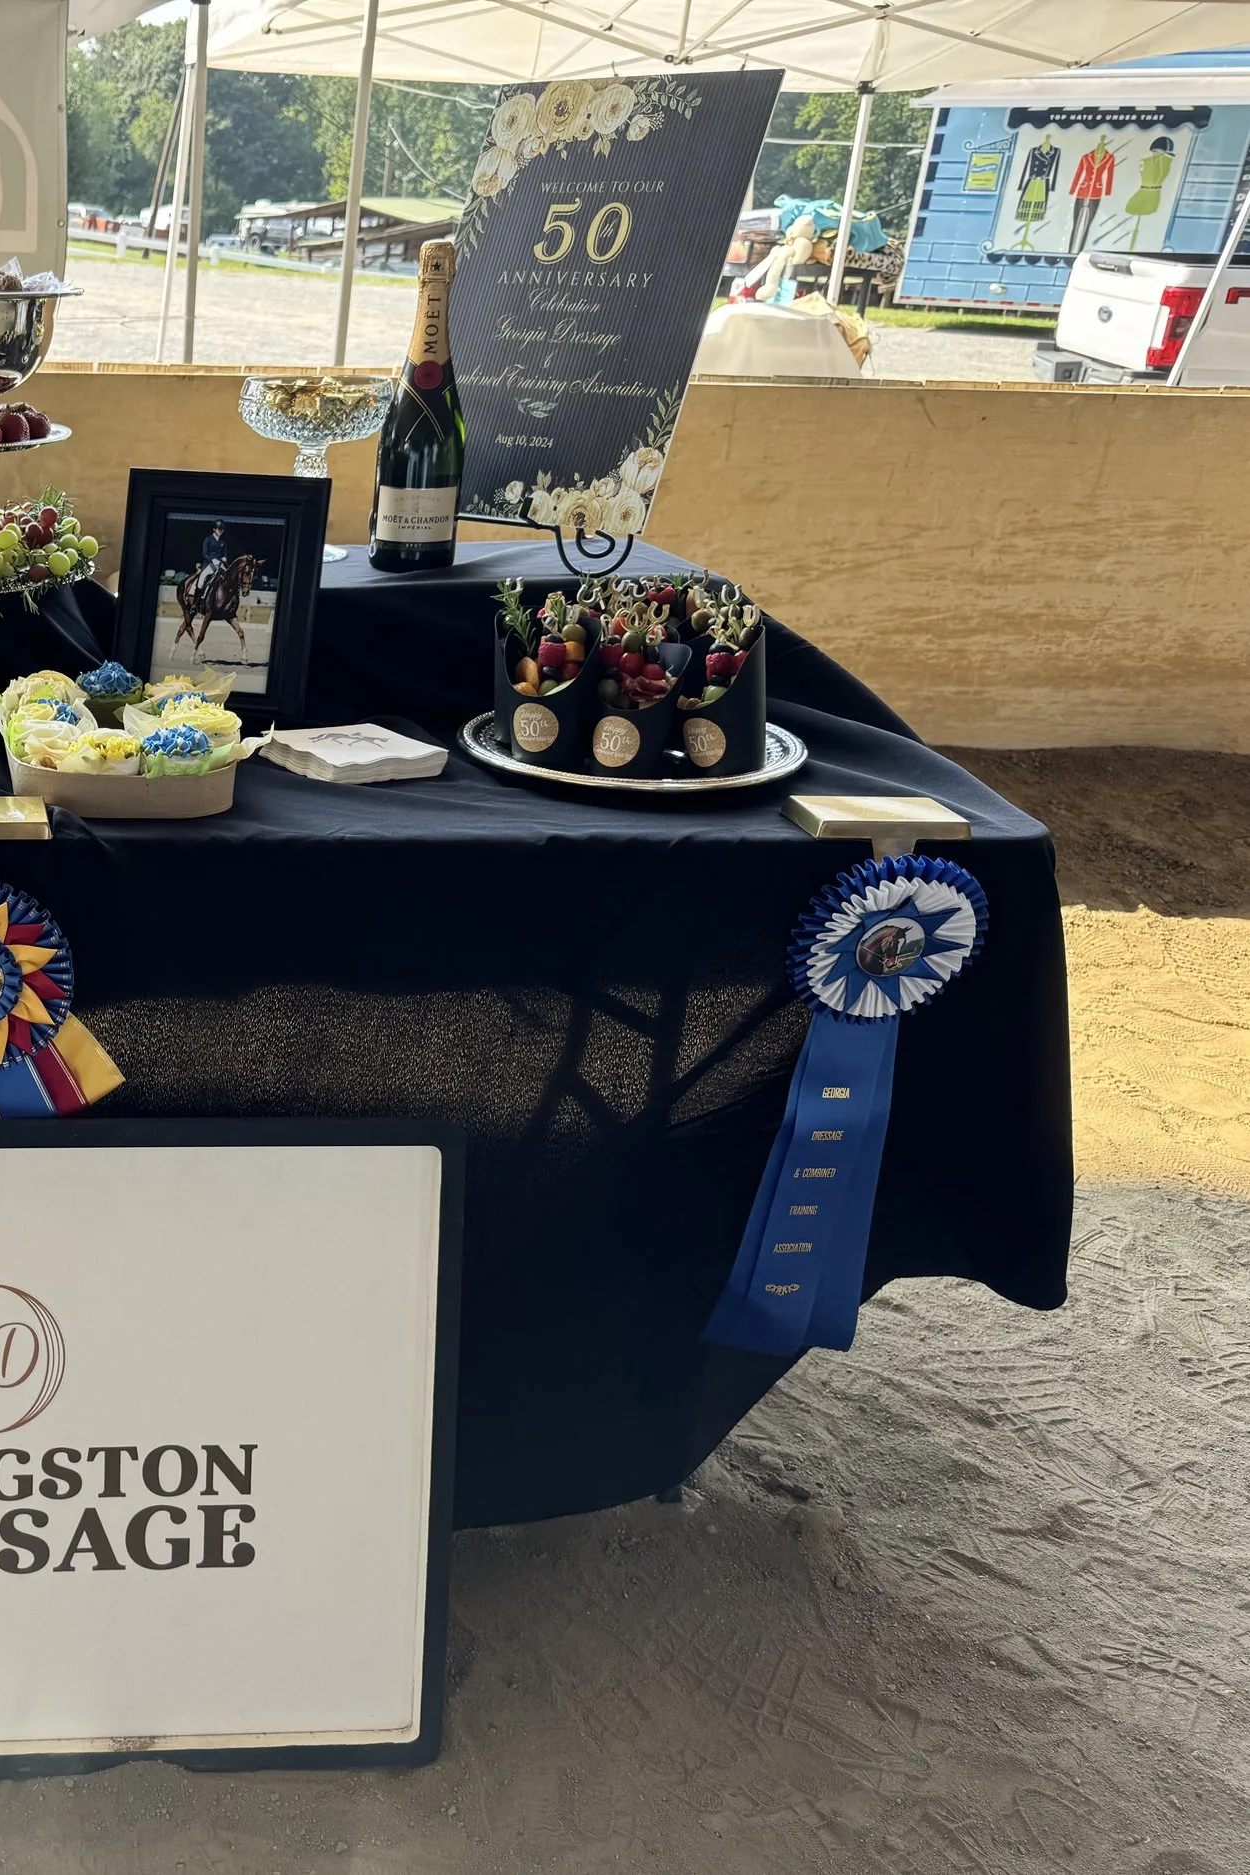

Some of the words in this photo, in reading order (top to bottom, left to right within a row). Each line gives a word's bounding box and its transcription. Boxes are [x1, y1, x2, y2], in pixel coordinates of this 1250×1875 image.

[541, 181, 607, 194] WELCOME
[611, 181, 630, 193] TO
[633, 181, 664, 193] OUR
[497, 271, 654, 288] ANNIVERSARY
[528, 288, 601, 314] Celebration
[494, 314, 548, 348] Georgia
[547, 317, 622, 355] Dressage
[455, 364, 508, 388] mbined
[506, 364, 568, 399] Training
[568, 369, 658, 398] Association
[494, 434, 513, 449] Aug
[530, 436, 554, 449] 2024
[822, 1087, 850, 1098] GEORGIA
[811, 1131, 844, 1140] DRESSAGE
[802, 1167, 836, 1177] COMBINED
[789, 1205, 818, 1215] TRAINING
[773, 1243, 812, 1253] ASSOCIATION
